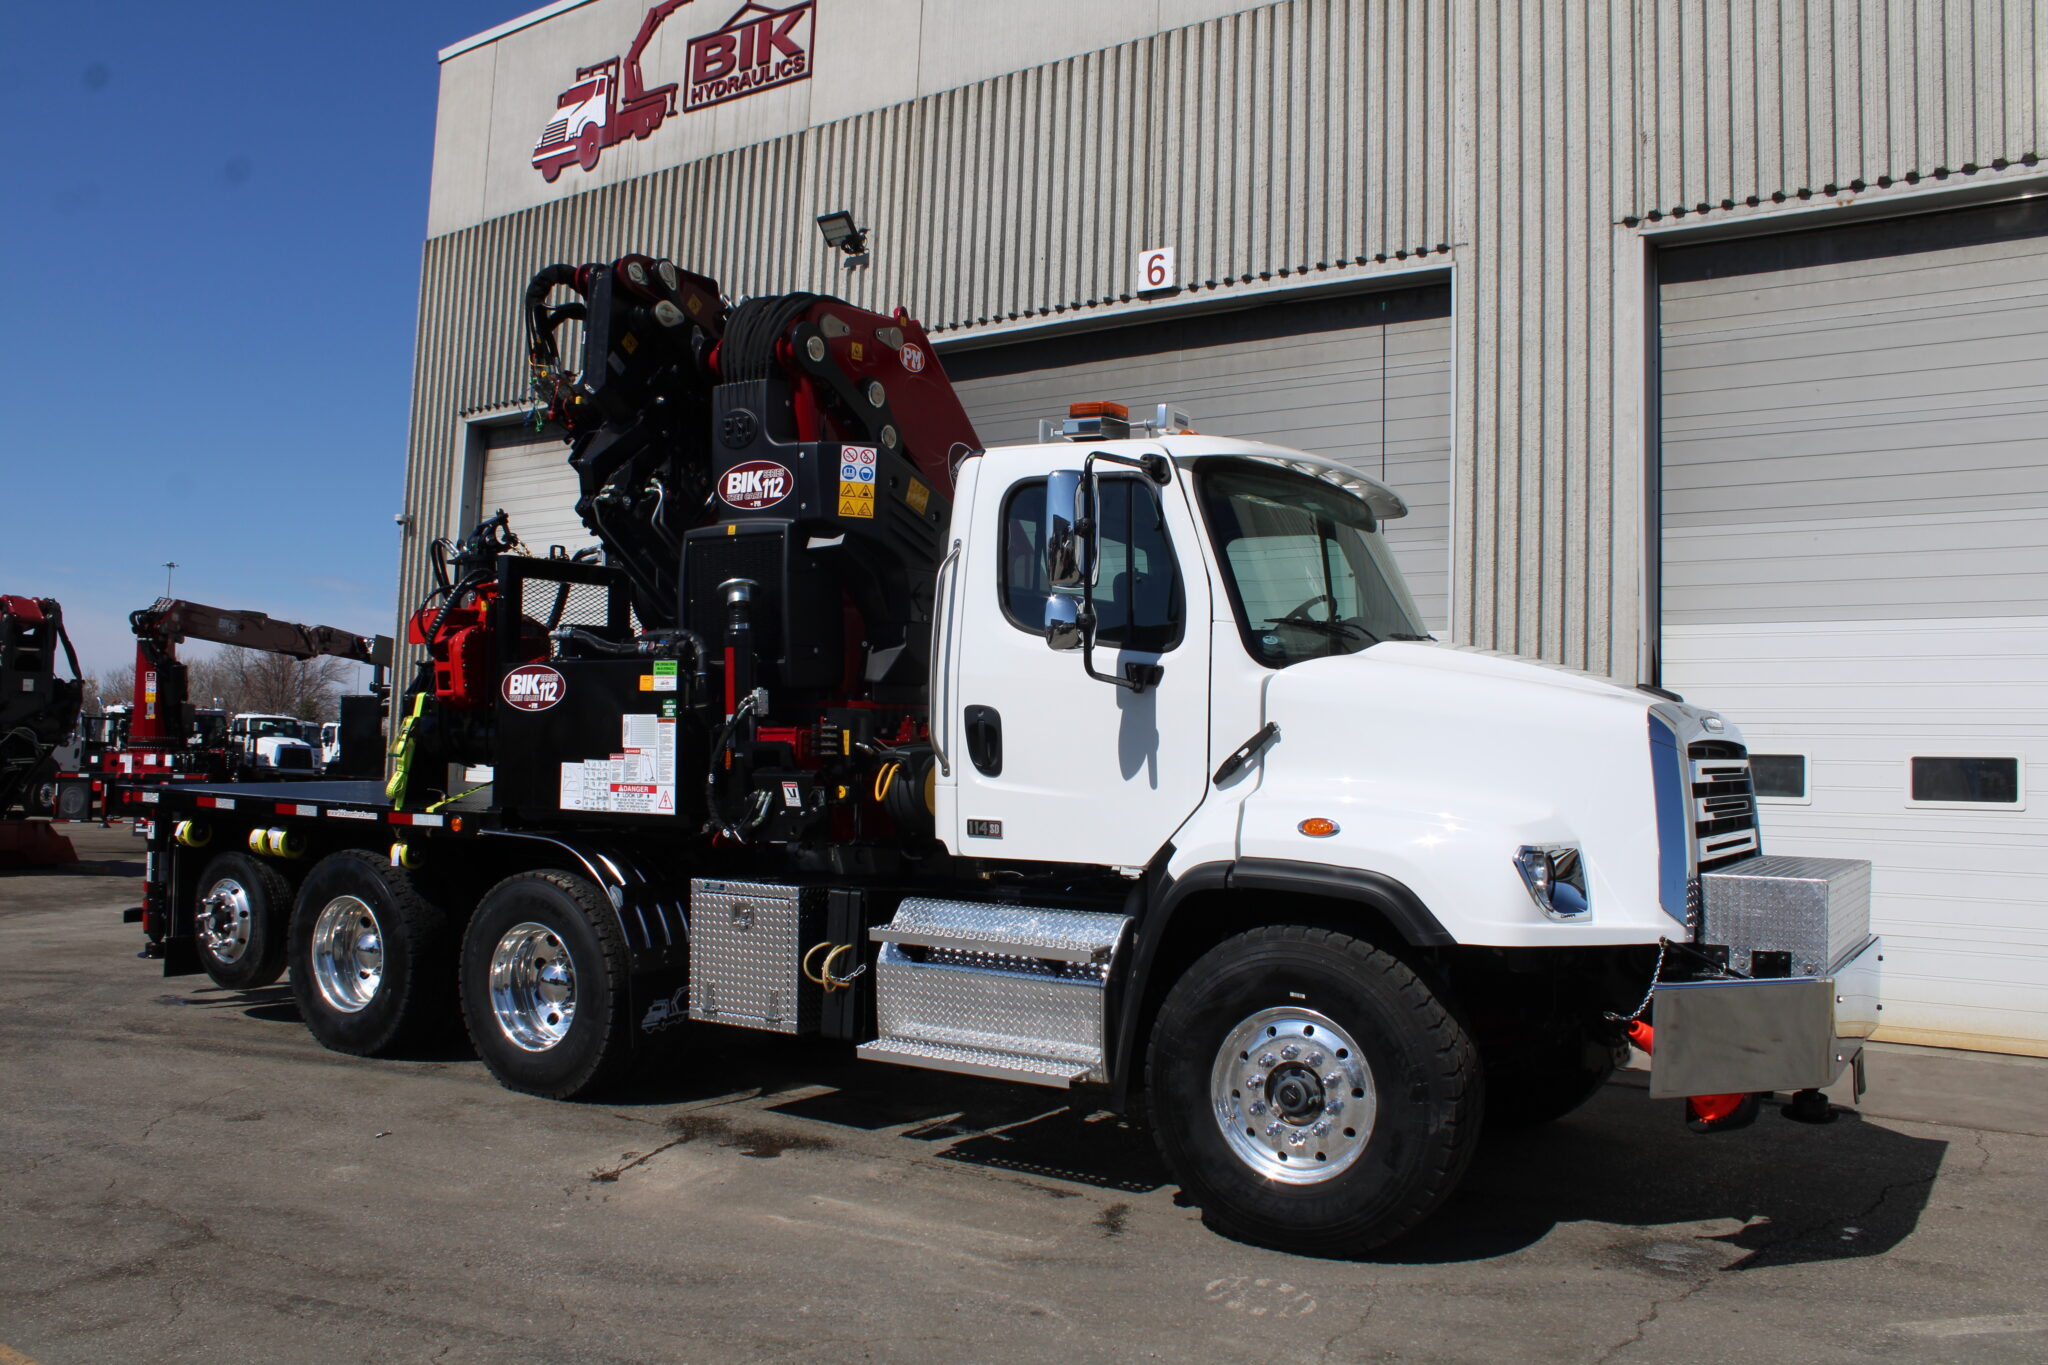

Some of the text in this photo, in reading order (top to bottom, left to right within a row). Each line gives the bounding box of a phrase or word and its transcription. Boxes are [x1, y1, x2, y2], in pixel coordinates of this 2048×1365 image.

[693, 9, 806, 84] BIK
[691, 55, 805, 104] HYDRAULICS
[1147, 253, 1165, 286] 6
[903, 346, 922, 370] PM
[727, 470, 763, 494] BIK
[762, 477, 784, 498] 112
[509, 674, 541, 694] BIK
[539, 682, 557, 701] 112
[623, 785, 649, 793] DANGER
[969, 821, 1000, 835] 114 SD
